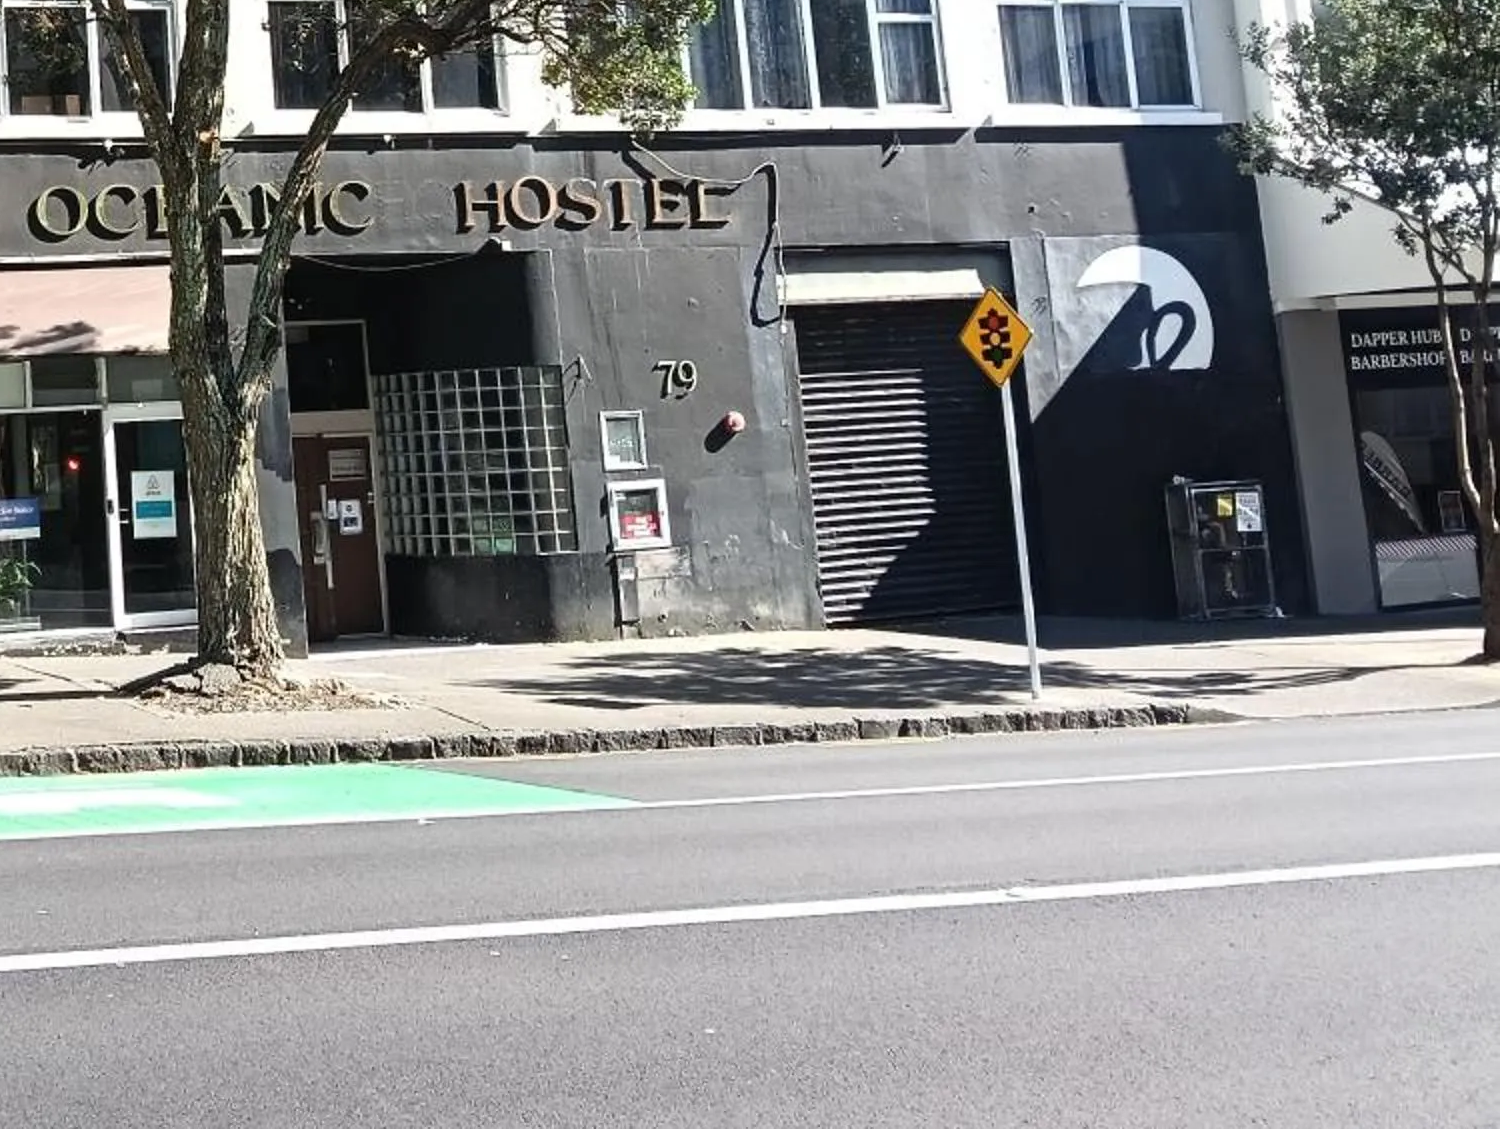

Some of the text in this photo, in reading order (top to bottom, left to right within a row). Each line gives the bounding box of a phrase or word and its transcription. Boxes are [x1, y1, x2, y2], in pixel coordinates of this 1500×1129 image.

[456, 175, 732, 231] HOSTEL
[1351, 330, 1409, 348] DAPPER
[1412, 328, 1442, 344] HUB
[654, 360, 698, 397] 79
